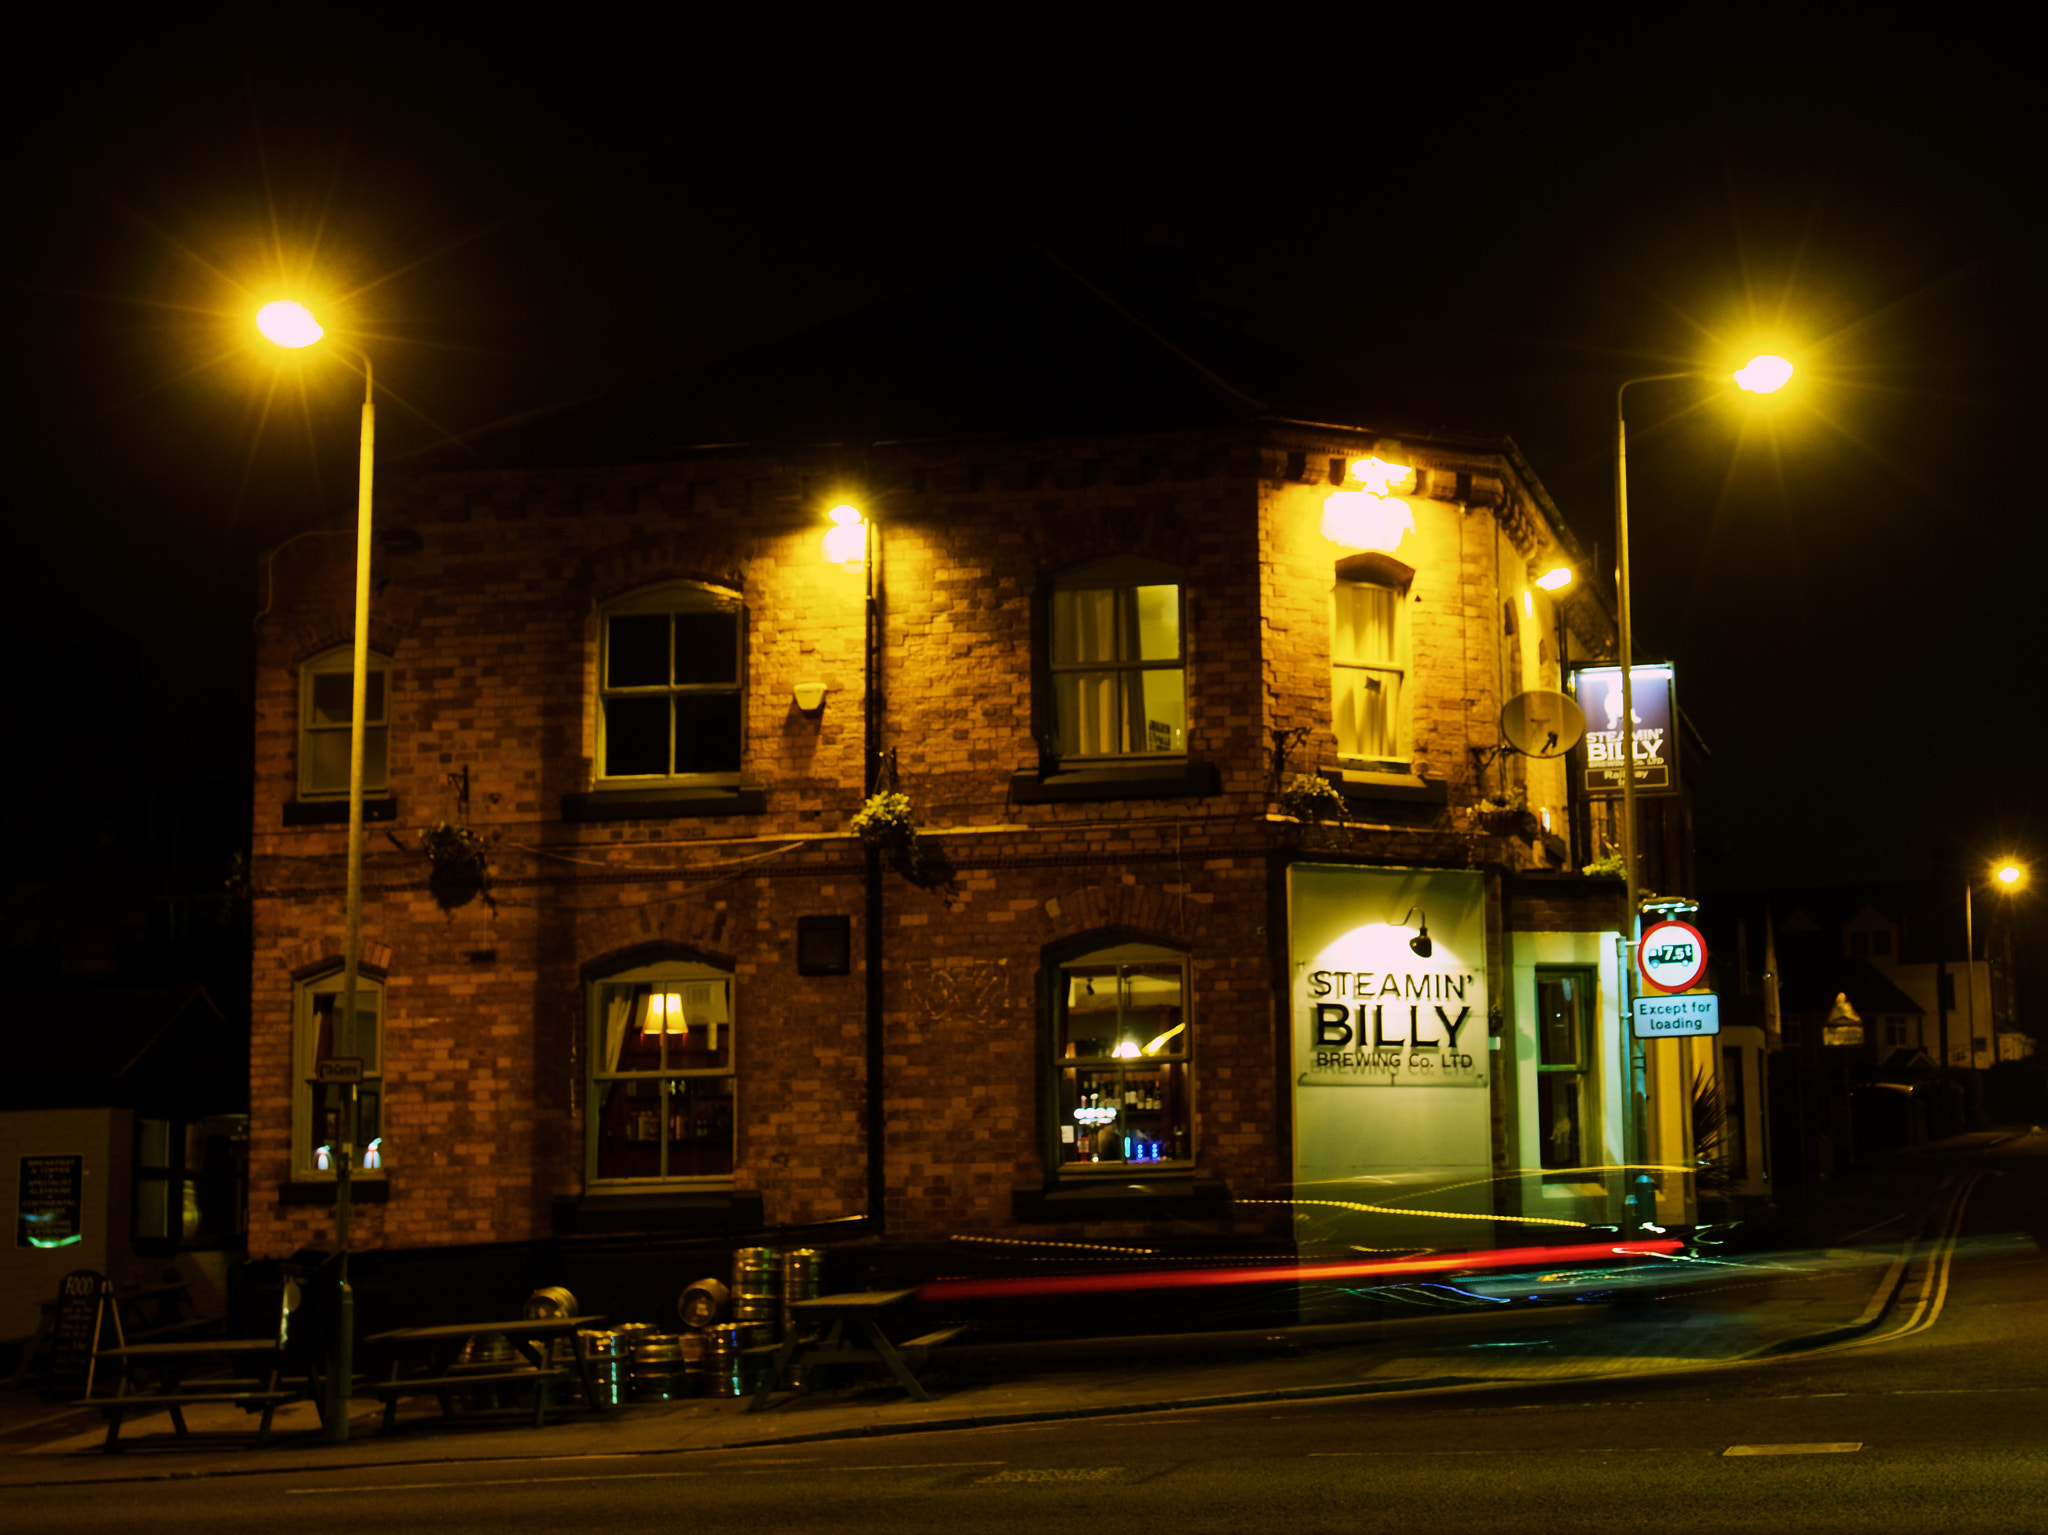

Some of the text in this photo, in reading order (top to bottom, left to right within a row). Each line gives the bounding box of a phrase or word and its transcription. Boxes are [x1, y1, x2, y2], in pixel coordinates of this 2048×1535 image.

[1587, 739, 1664, 761] BILLY
[1604, 770, 1649, 780] Railay
[1314, 971, 1473, 999] STEAMIN'
[1640, 1002, 1712, 1016] Except for
[1316, 1003, 1471, 1048] BILLY
[1650, 1019, 1703, 1031] loading
[1317, 1052, 1473, 1068] BREWING Co. LTD
